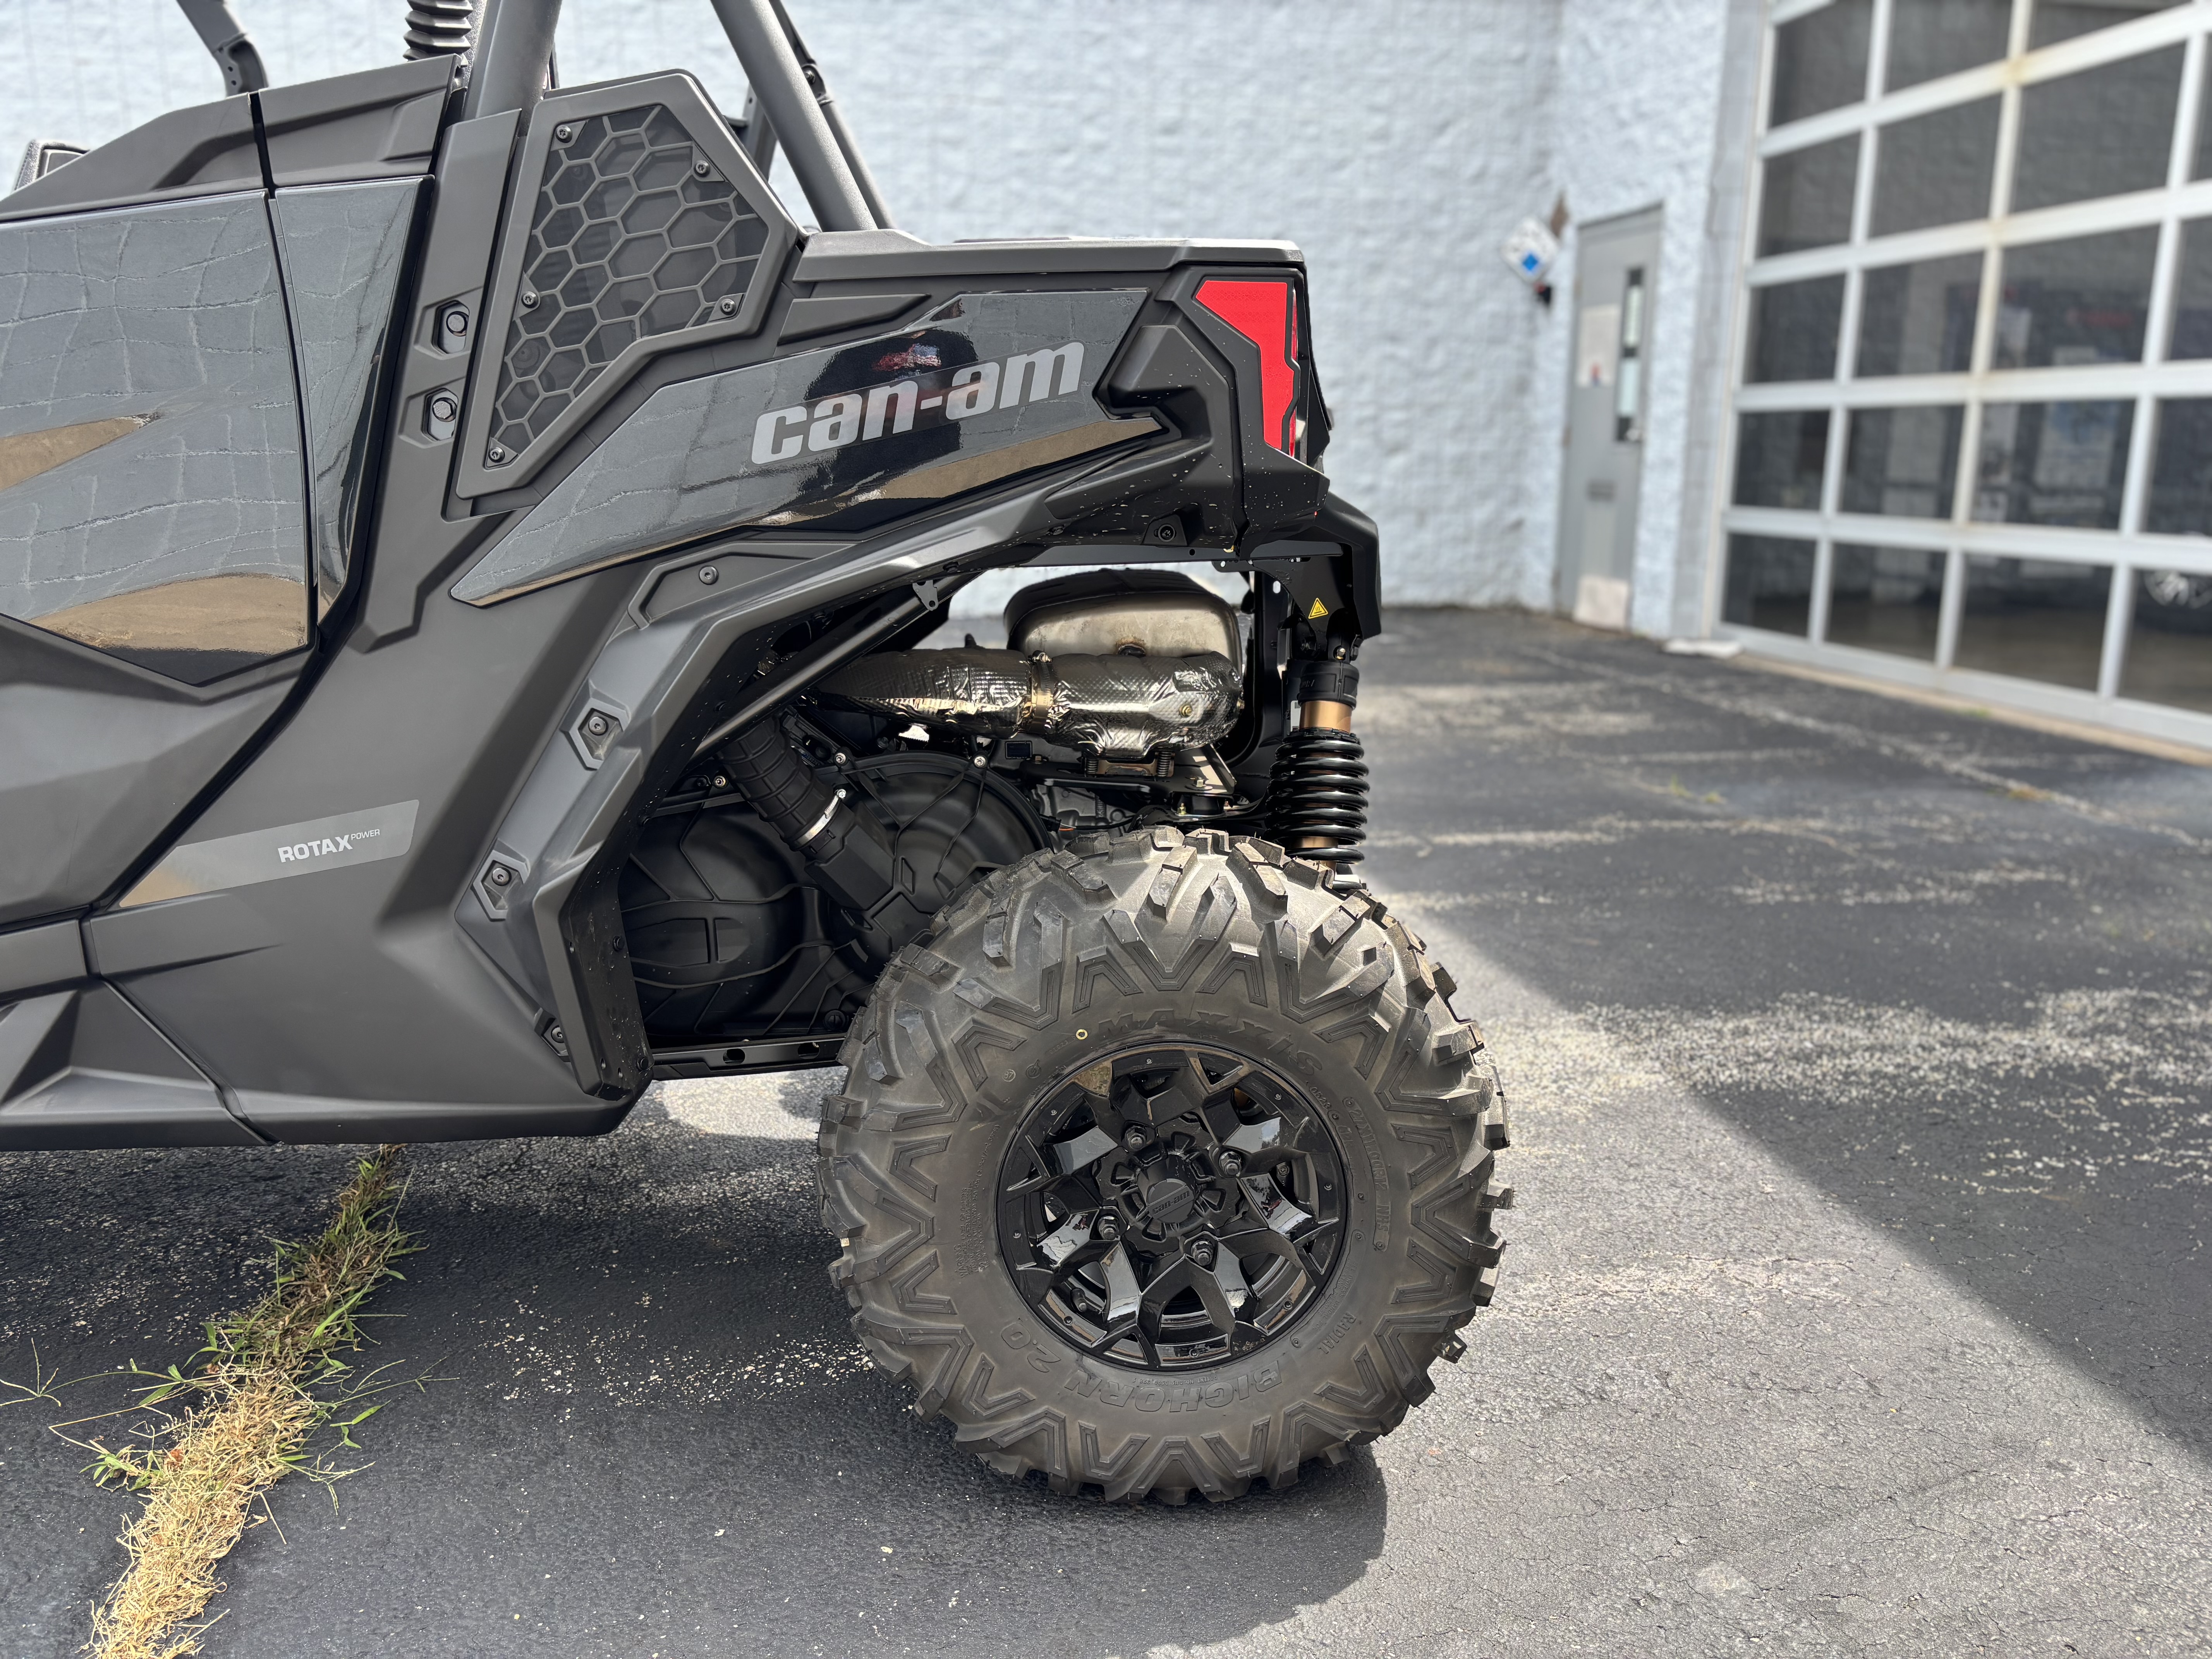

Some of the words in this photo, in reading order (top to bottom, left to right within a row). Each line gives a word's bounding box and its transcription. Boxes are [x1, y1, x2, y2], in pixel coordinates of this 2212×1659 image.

[750, 341, 1085, 465] can-am
[277, 834, 353, 862] ROTAX
[351, 829, 380, 841] POWER
[1097, 1008, 1322, 1076] MAXXIS
[1152, 1190, 1190, 1215] can-am
[1001, 1321, 1061, 1373] 2.0
[1317, 1312, 1357, 1354] RADIAL
[1064, 1360, 1283, 1413] BIGHORN
